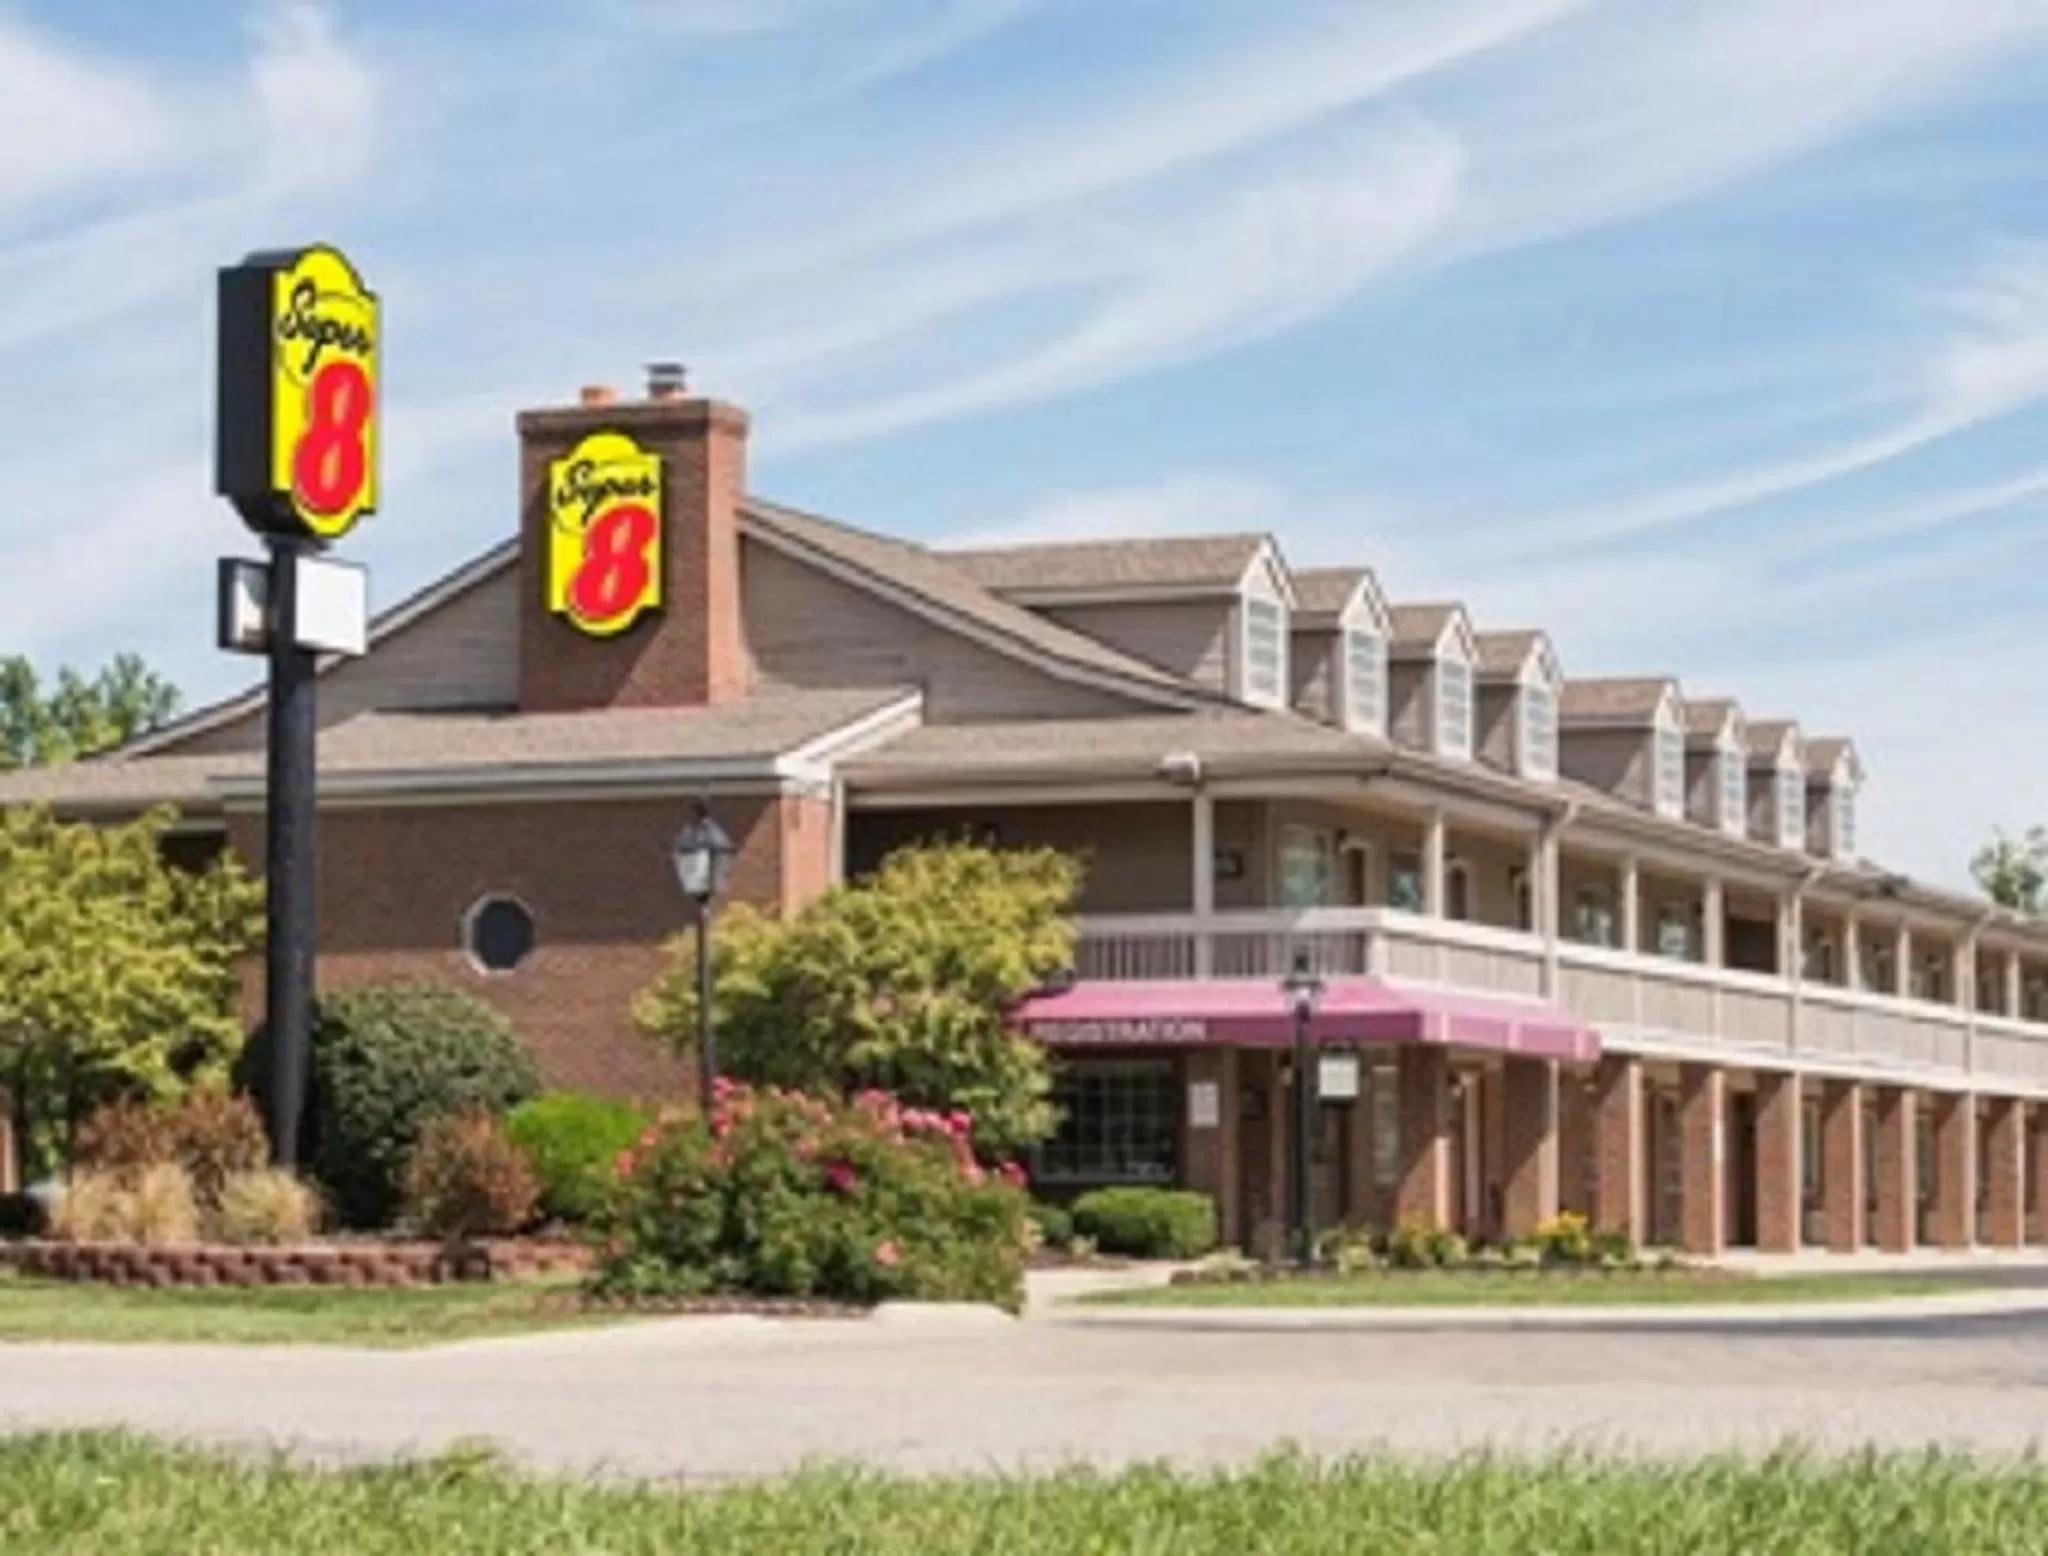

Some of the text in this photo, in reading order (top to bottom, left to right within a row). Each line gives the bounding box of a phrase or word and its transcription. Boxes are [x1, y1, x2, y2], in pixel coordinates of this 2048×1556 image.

[278, 277, 370, 374] Super
[294, 360, 370, 514] 8
[556, 460, 657, 525] Super
[568, 503, 660, 619] 8
